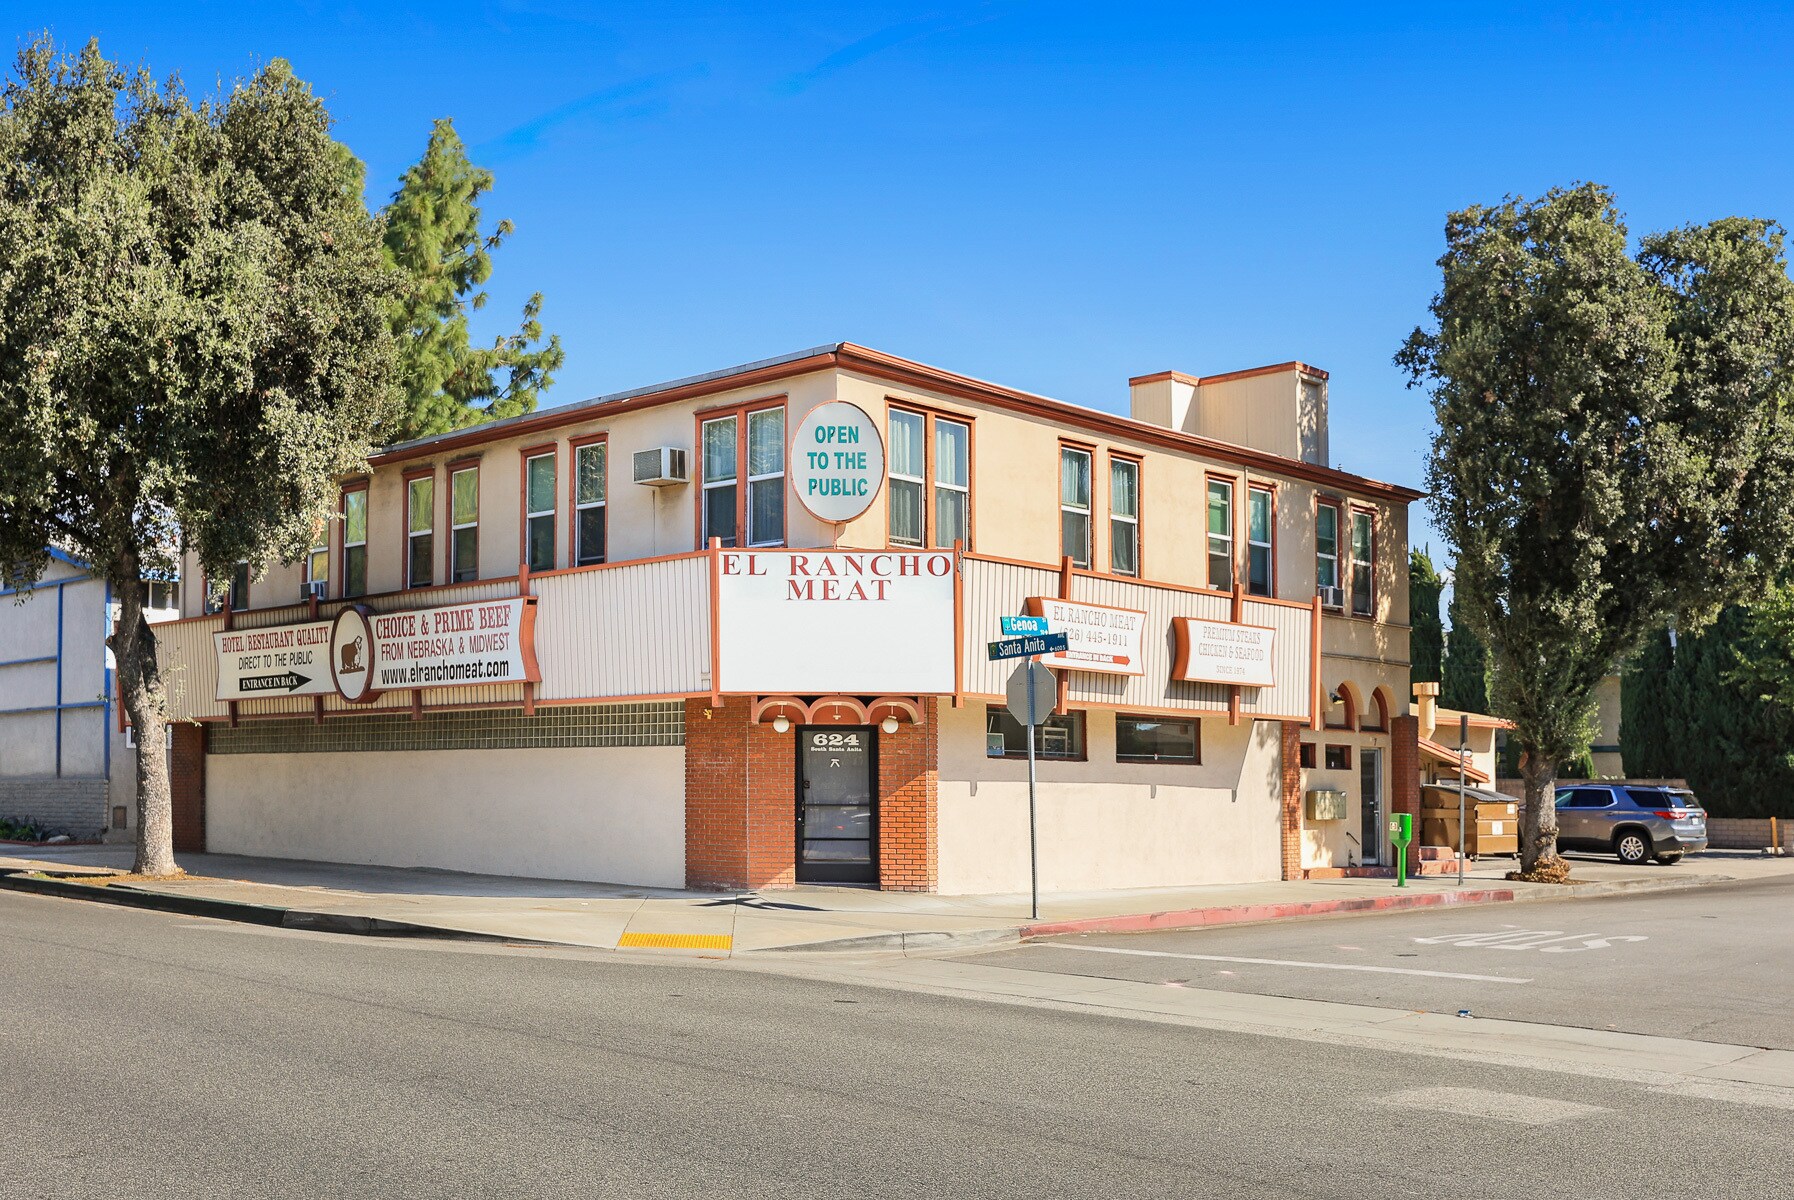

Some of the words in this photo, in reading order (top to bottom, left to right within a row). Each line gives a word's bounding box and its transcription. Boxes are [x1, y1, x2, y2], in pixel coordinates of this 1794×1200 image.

[815, 425, 859, 444] OPEN
[807, 451, 829, 470] TO
[834, 452, 867, 470] THE
[808, 478, 868, 496] PUBLIC
[722, 554, 768, 576] EL
[790, 554, 951, 577] RANCHO
[786, 579, 892, 601] MEAT
[375, 615, 416, 640] CHOICE
[420, 614, 430, 636] &
[433, 608, 475, 634] PRIME
[478, 604, 512, 630] BEEF
[1010, 618, 1038, 631] Genoa
[1053, 605, 1065, 622] EL
[1068, 607, 1107, 628] RANCHO
[1109, 613, 1136, 631] MEAT
[296, 626, 329, 646] QUALITY
[1086, 630, 1128, 647] 445-1911
[381, 641, 404, 661] FROM
[407, 637, 454, 659] NEBRASKA
[458, 636, 466, 654] &
[469, 632, 510, 654] MIDWEST
[999, 641, 1022, 657] Santa
[1024, 637, 1046, 653] Anita
[238, 655, 261, 670] DIRECT
[263, 654, 272, 668] TO
[274, 652, 287, 667] THE
[289, 650, 313, 666] PUBLIC
[381, 659, 510, 685] www.elranchomeat.com
[242, 678, 273, 690] ENTRANCE
[273, 677, 281, 687] IN
[281, 675, 298, 687] BACK
[813, 733, 860, 746] 624
